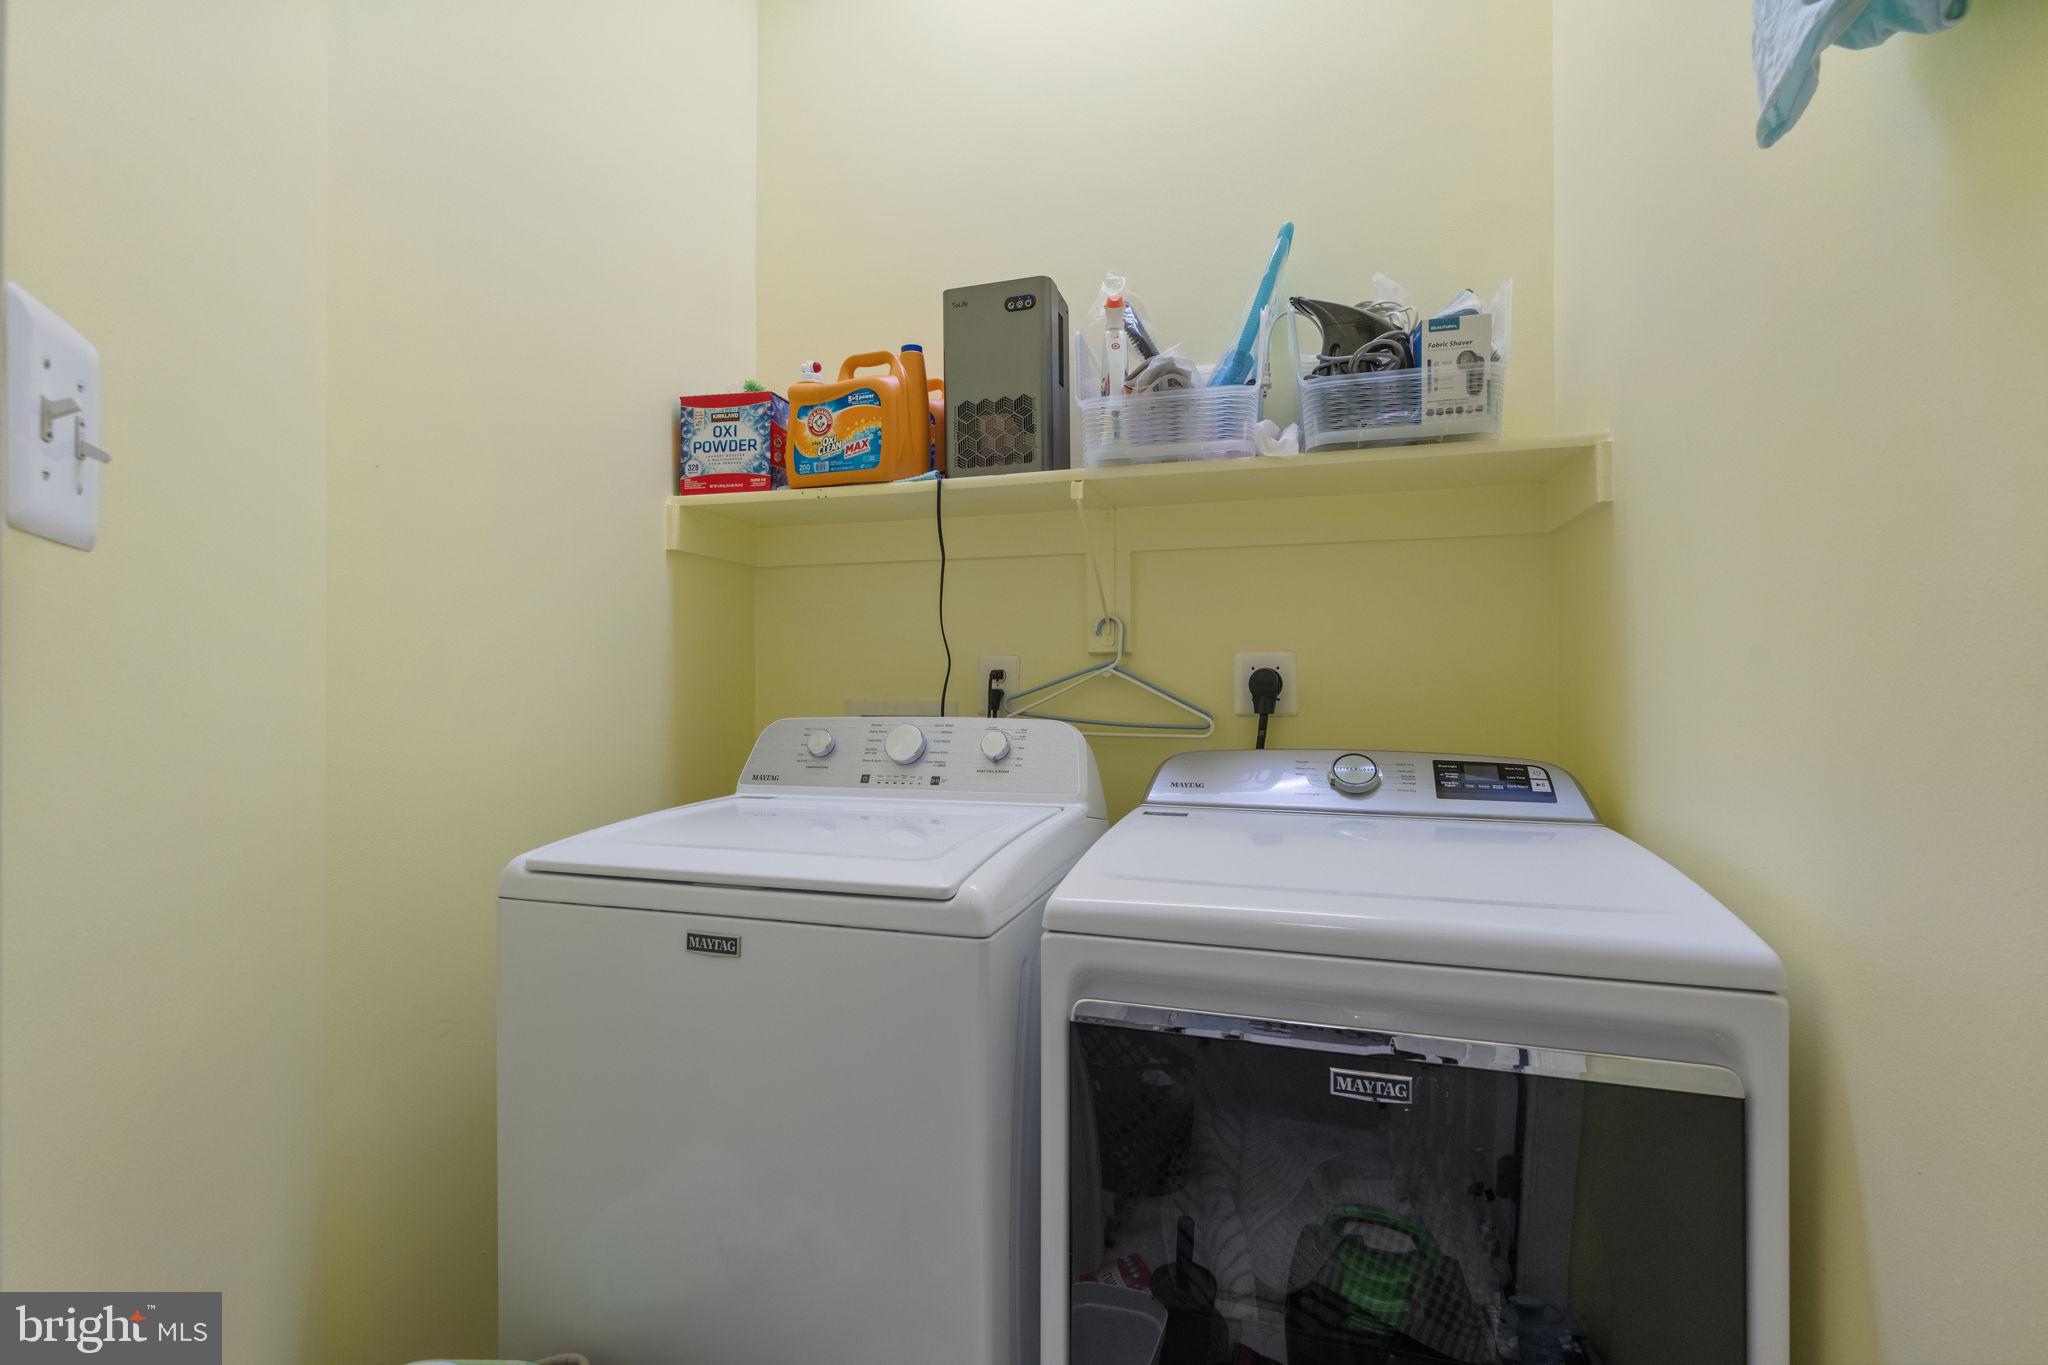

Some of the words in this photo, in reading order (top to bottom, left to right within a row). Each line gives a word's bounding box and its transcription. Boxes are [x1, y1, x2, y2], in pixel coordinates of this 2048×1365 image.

[1427, 341, 1448, 349] Fabric
[713, 425, 737, 438] OXI
[693, 438, 758, 454] POWDER
[818, 440, 842, 456] CLEAN
[823, 435, 838, 446] OXI
[845, 438, 869, 454] MAX
[689, 936, 736, 952] MAYTAG
[1336, 1076, 1408, 1098] MAYTAG
